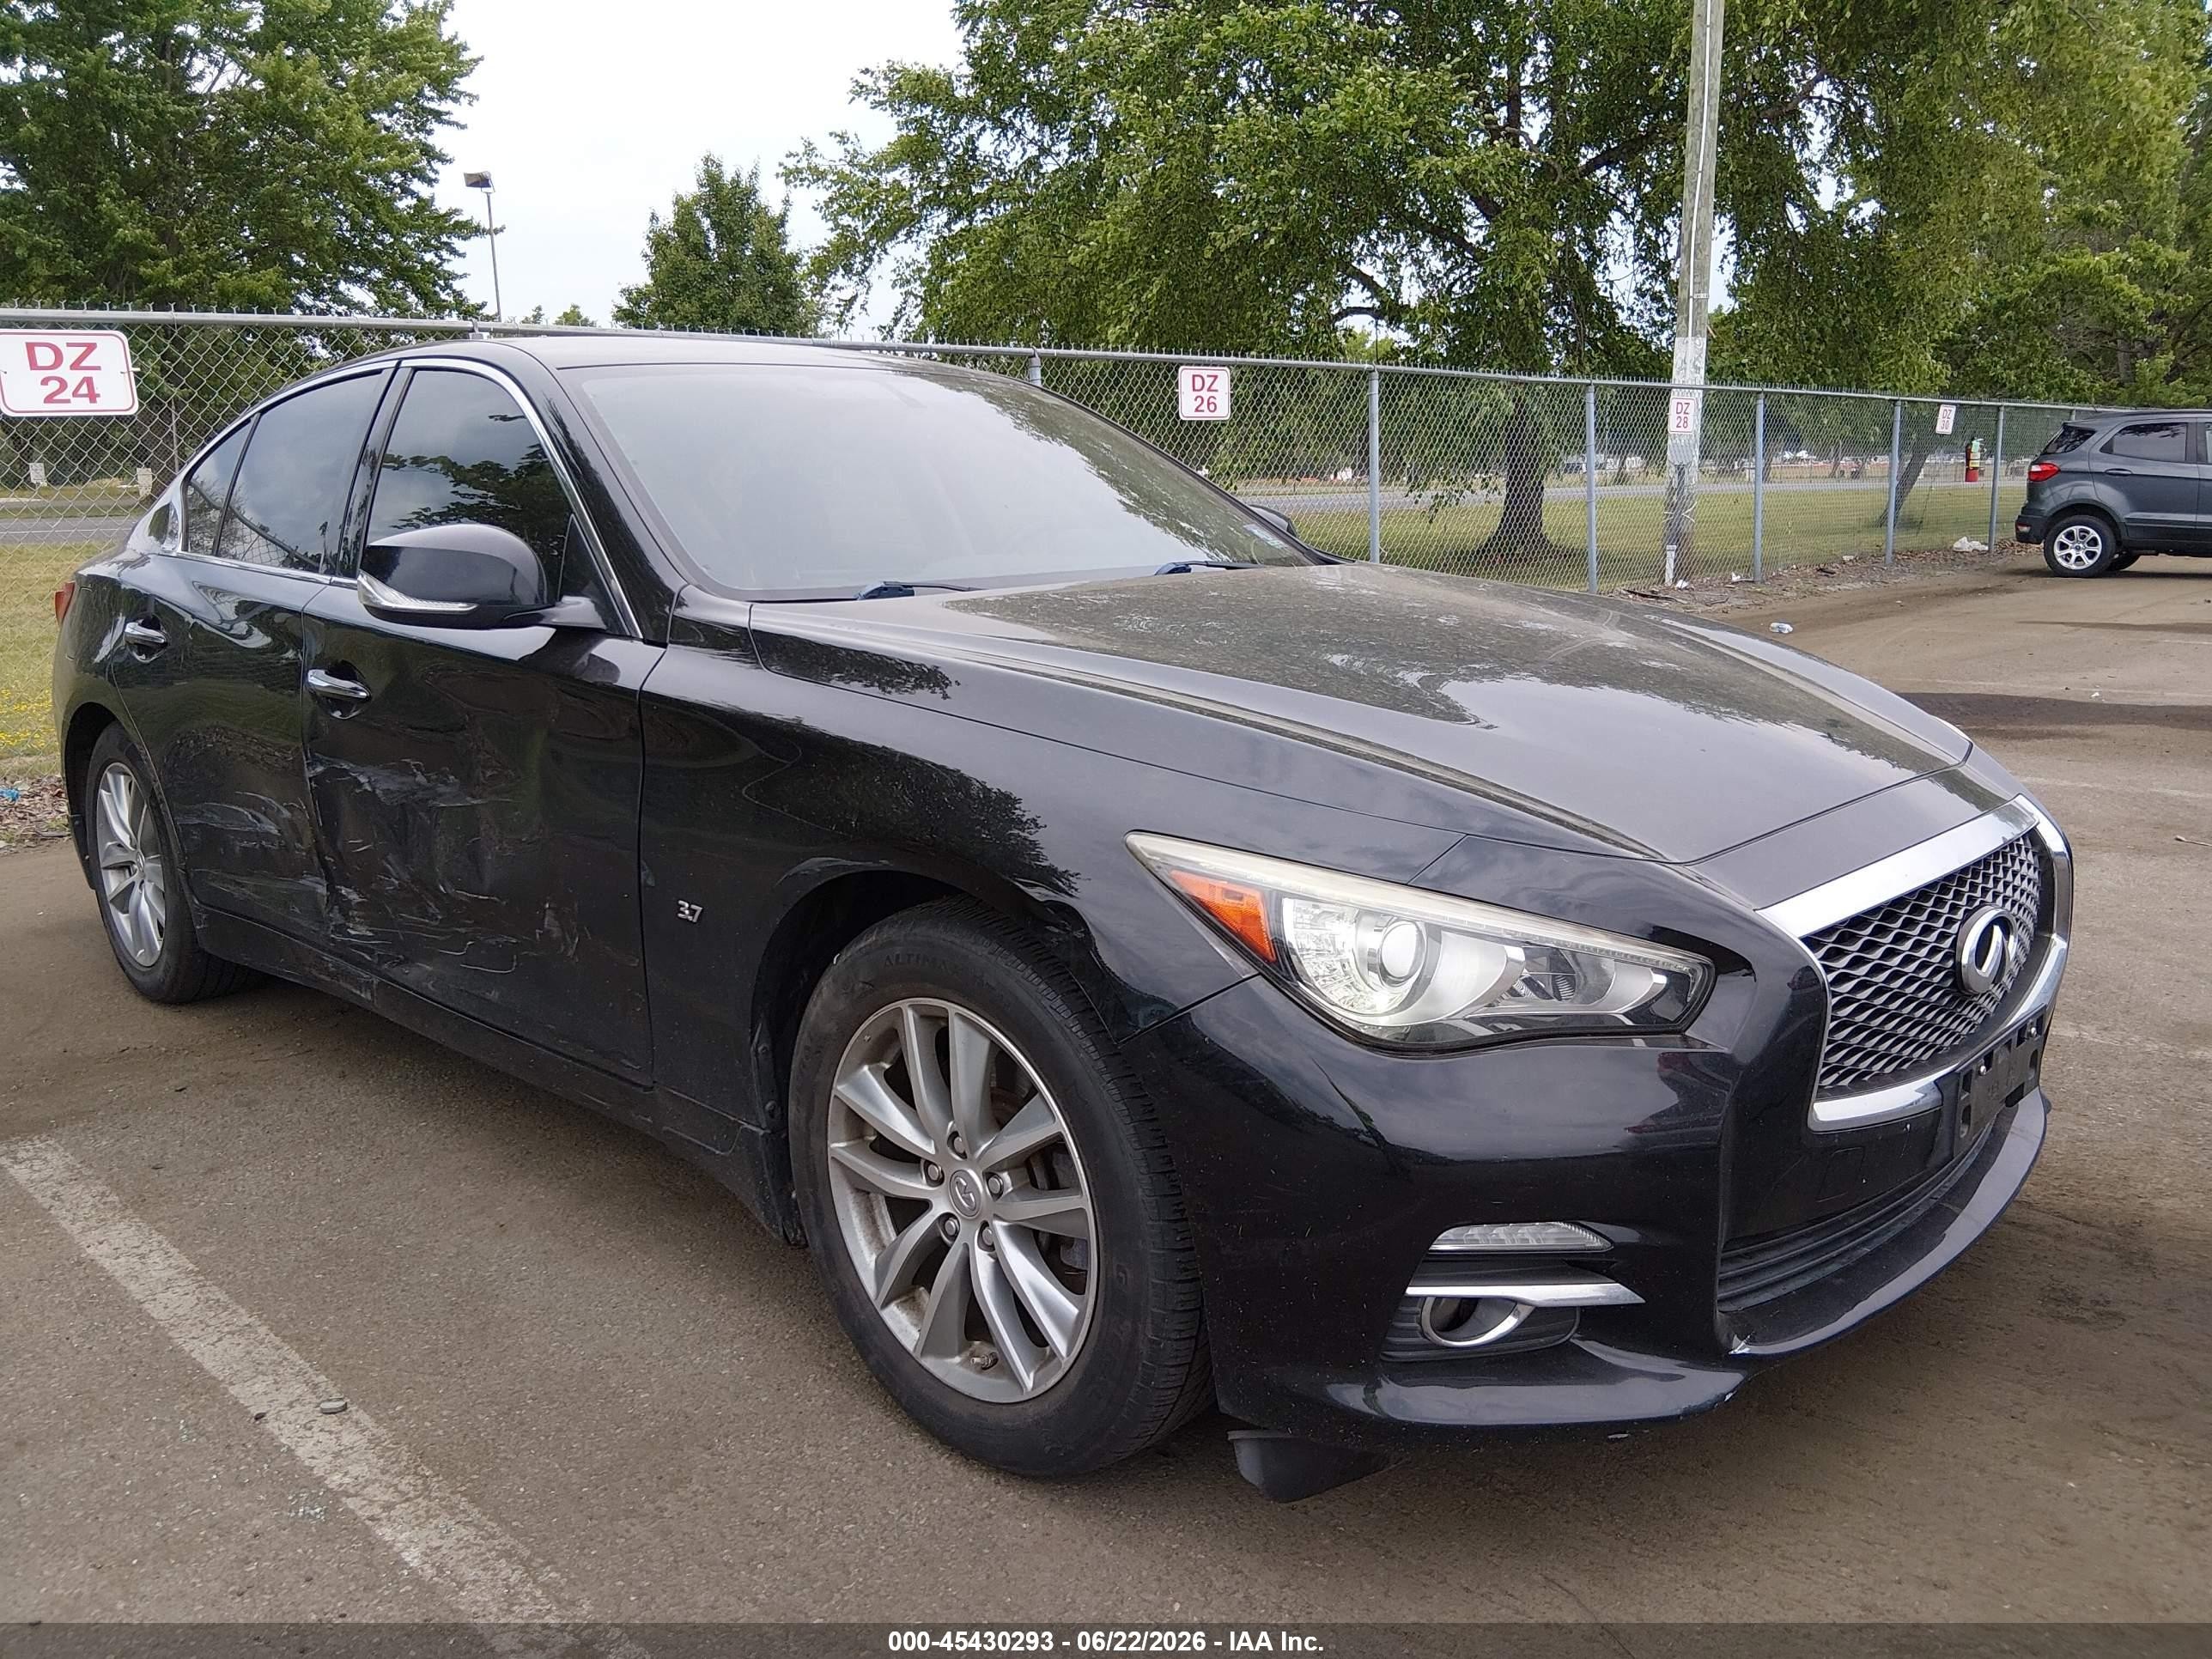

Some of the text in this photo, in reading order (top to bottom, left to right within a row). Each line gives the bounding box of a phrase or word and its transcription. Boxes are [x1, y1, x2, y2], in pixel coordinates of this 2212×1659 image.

[25, 342, 101, 371] DZ
[40, 375, 100, 404] 24
[1192, 374, 1218, 392] DZ
[1194, 395, 1217, 413] 26
[1675, 402, 1691, 415] DZ
[1942, 409, 1953, 419] DZ
[1675, 416, 1688, 428] 28
[1941, 420, 1950, 430] 30
